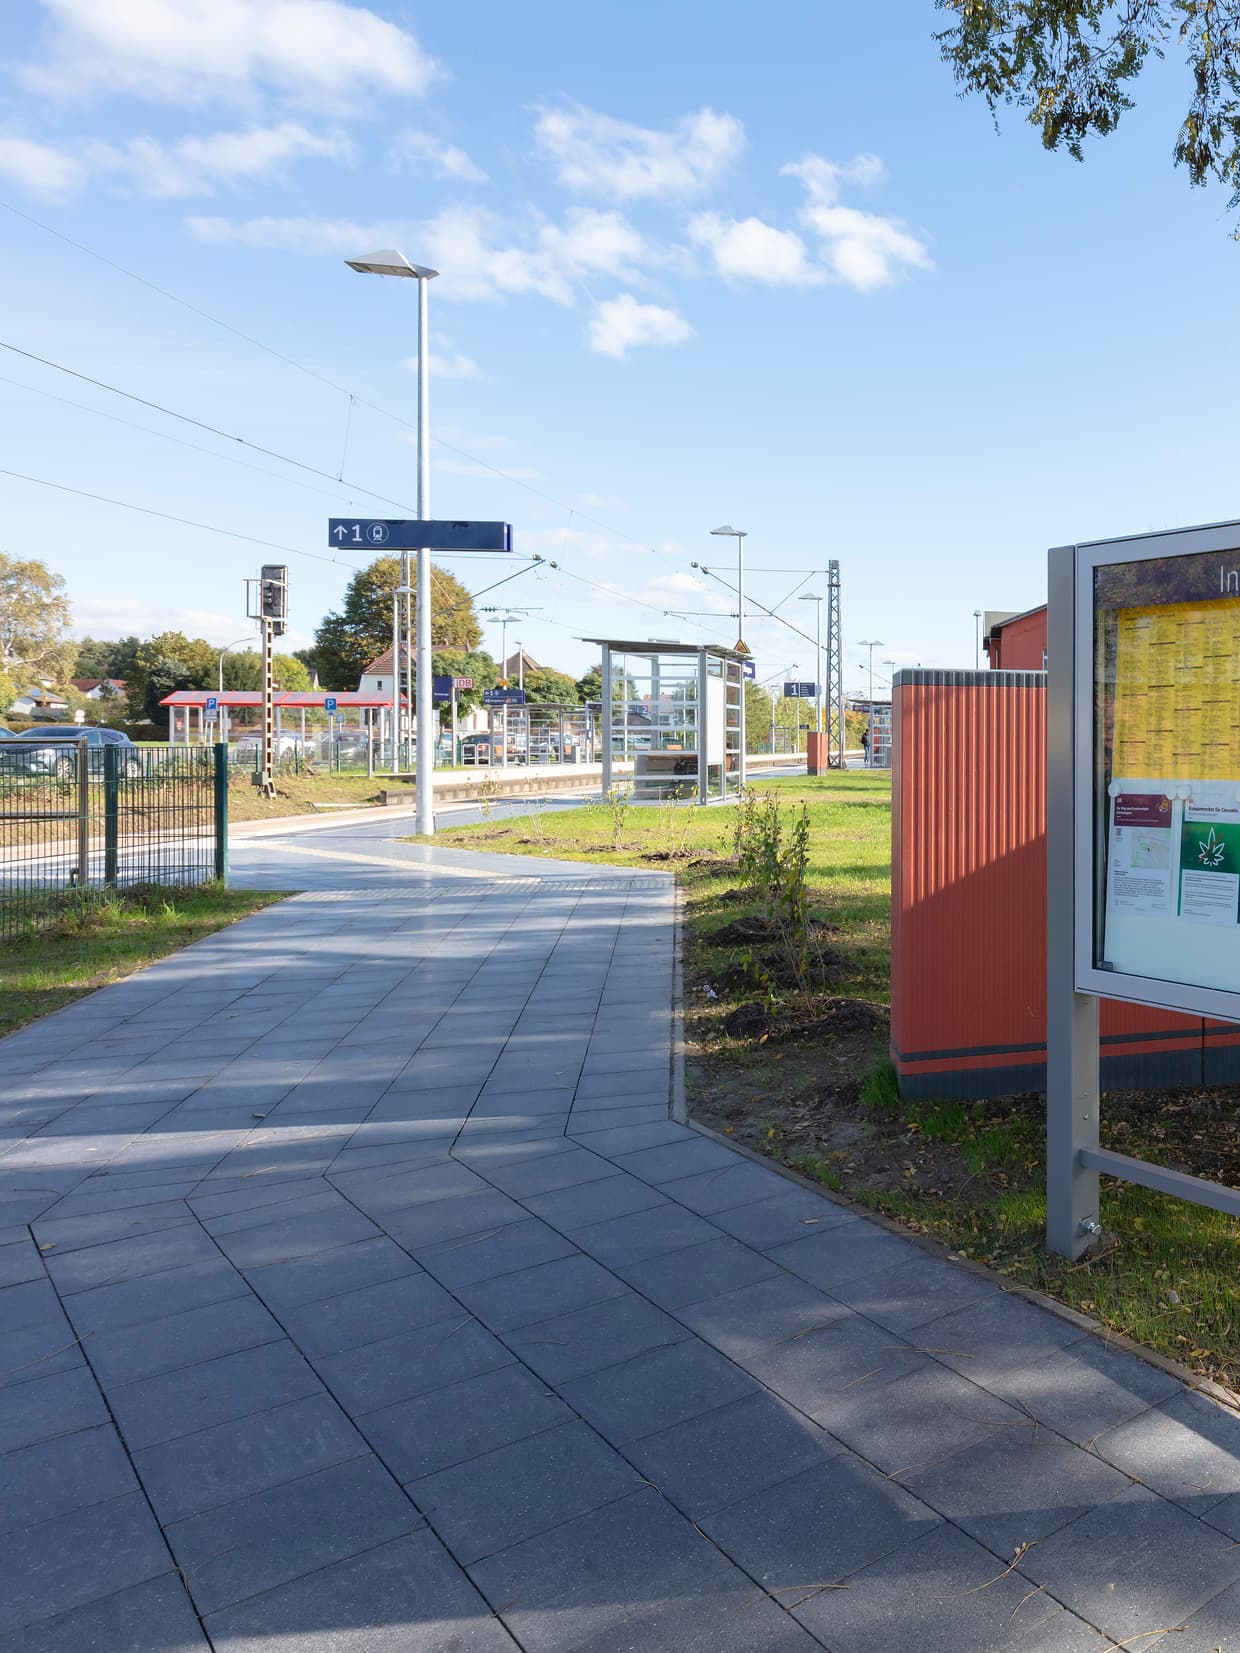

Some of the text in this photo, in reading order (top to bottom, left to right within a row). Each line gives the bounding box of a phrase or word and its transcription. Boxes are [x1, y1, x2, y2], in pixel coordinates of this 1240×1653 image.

[351, 524, 363, 542] 1
[459, 679, 472, 688] DB
[791, 684, 799, 696] 1
[208, 699, 215, 709] P
[327, 699, 335, 709] P
